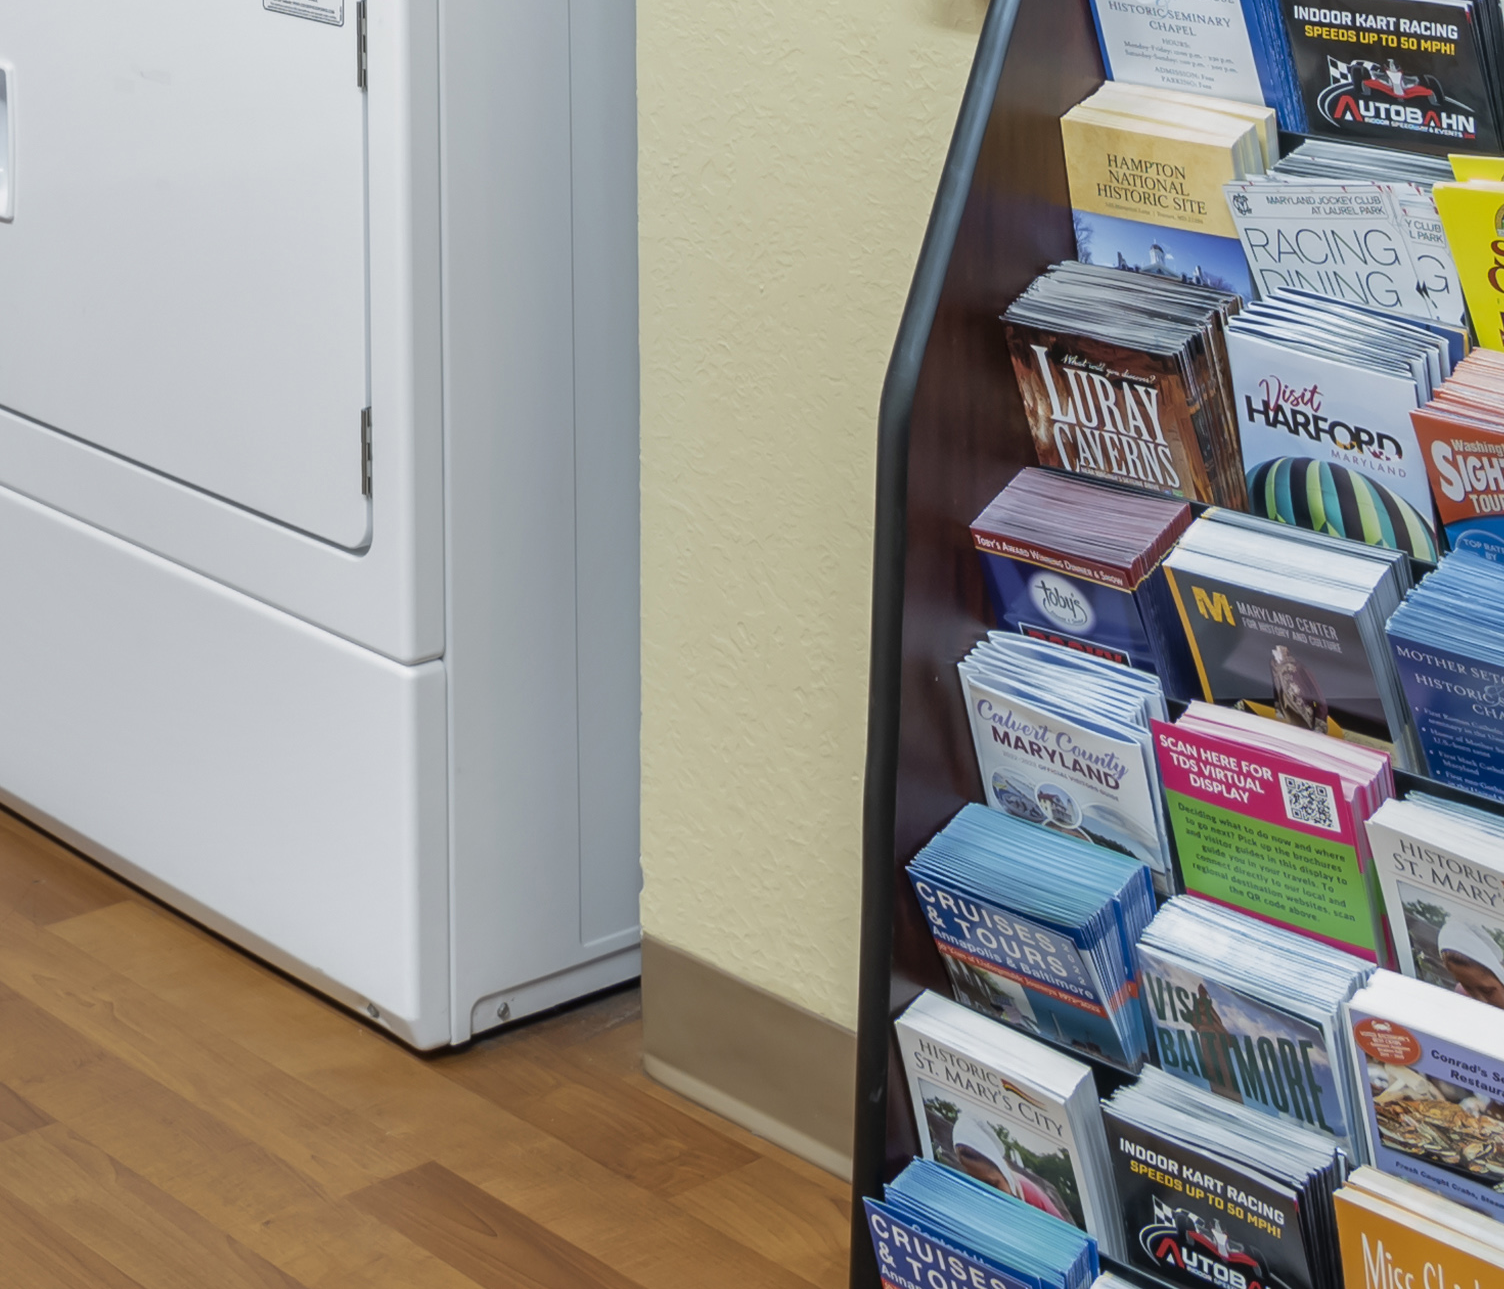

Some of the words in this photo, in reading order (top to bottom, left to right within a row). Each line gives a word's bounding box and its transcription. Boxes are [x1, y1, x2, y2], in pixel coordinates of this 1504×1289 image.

[1293, 4, 1352, 26] INDOOR
[1355, 13, 1396, 32] KART
[1399, 18, 1458, 40] RACING
[1305, 25, 1355, 43] SPEEDS
[1359, 30, 1377, 44] UP
[1380, 33, 1397, 46] TO
[1401, 36, 1418, 49] 50
[1421, 38, 1455, 55] MPH!
[1333, 94, 1475, 134] AUTOBAHN
[1107, 153, 1185, 180] HAMPTON
[1108, 170, 1189, 196] NATIONAL
[1097, 184, 1169, 209] HISTORIC
[1173, 196, 1207, 214] SITE
[1266, 194, 1317, 205] MARYLAND
[1319, 195, 1353, 205] JOCKEY
[1357, 196, 1381, 205] CLUB
[1244, 227, 1401, 267] RACING
[1030, 344, 1169, 446] LURAY
[1259, 375, 1323, 413] Visit
[1246, 396, 1402, 461] HARFORD
[1052, 421, 1180, 488] CAVERNS
[1035, 580, 1083, 618] toby's
[1159, 734, 1197, 758] SCAN
[1200, 745, 1238, 768] HERE
[1241, 760, 1272, 782] FOR
[1169, 752, 1198, 772] TDS
[1200, 763, 1264, 794] VIRTUAL
[1189, 773, 1249, 804] DISPLAY
[1392, 853, 1423, 879] ST.
[1400, 839, 1500, 890] HISTORIC
